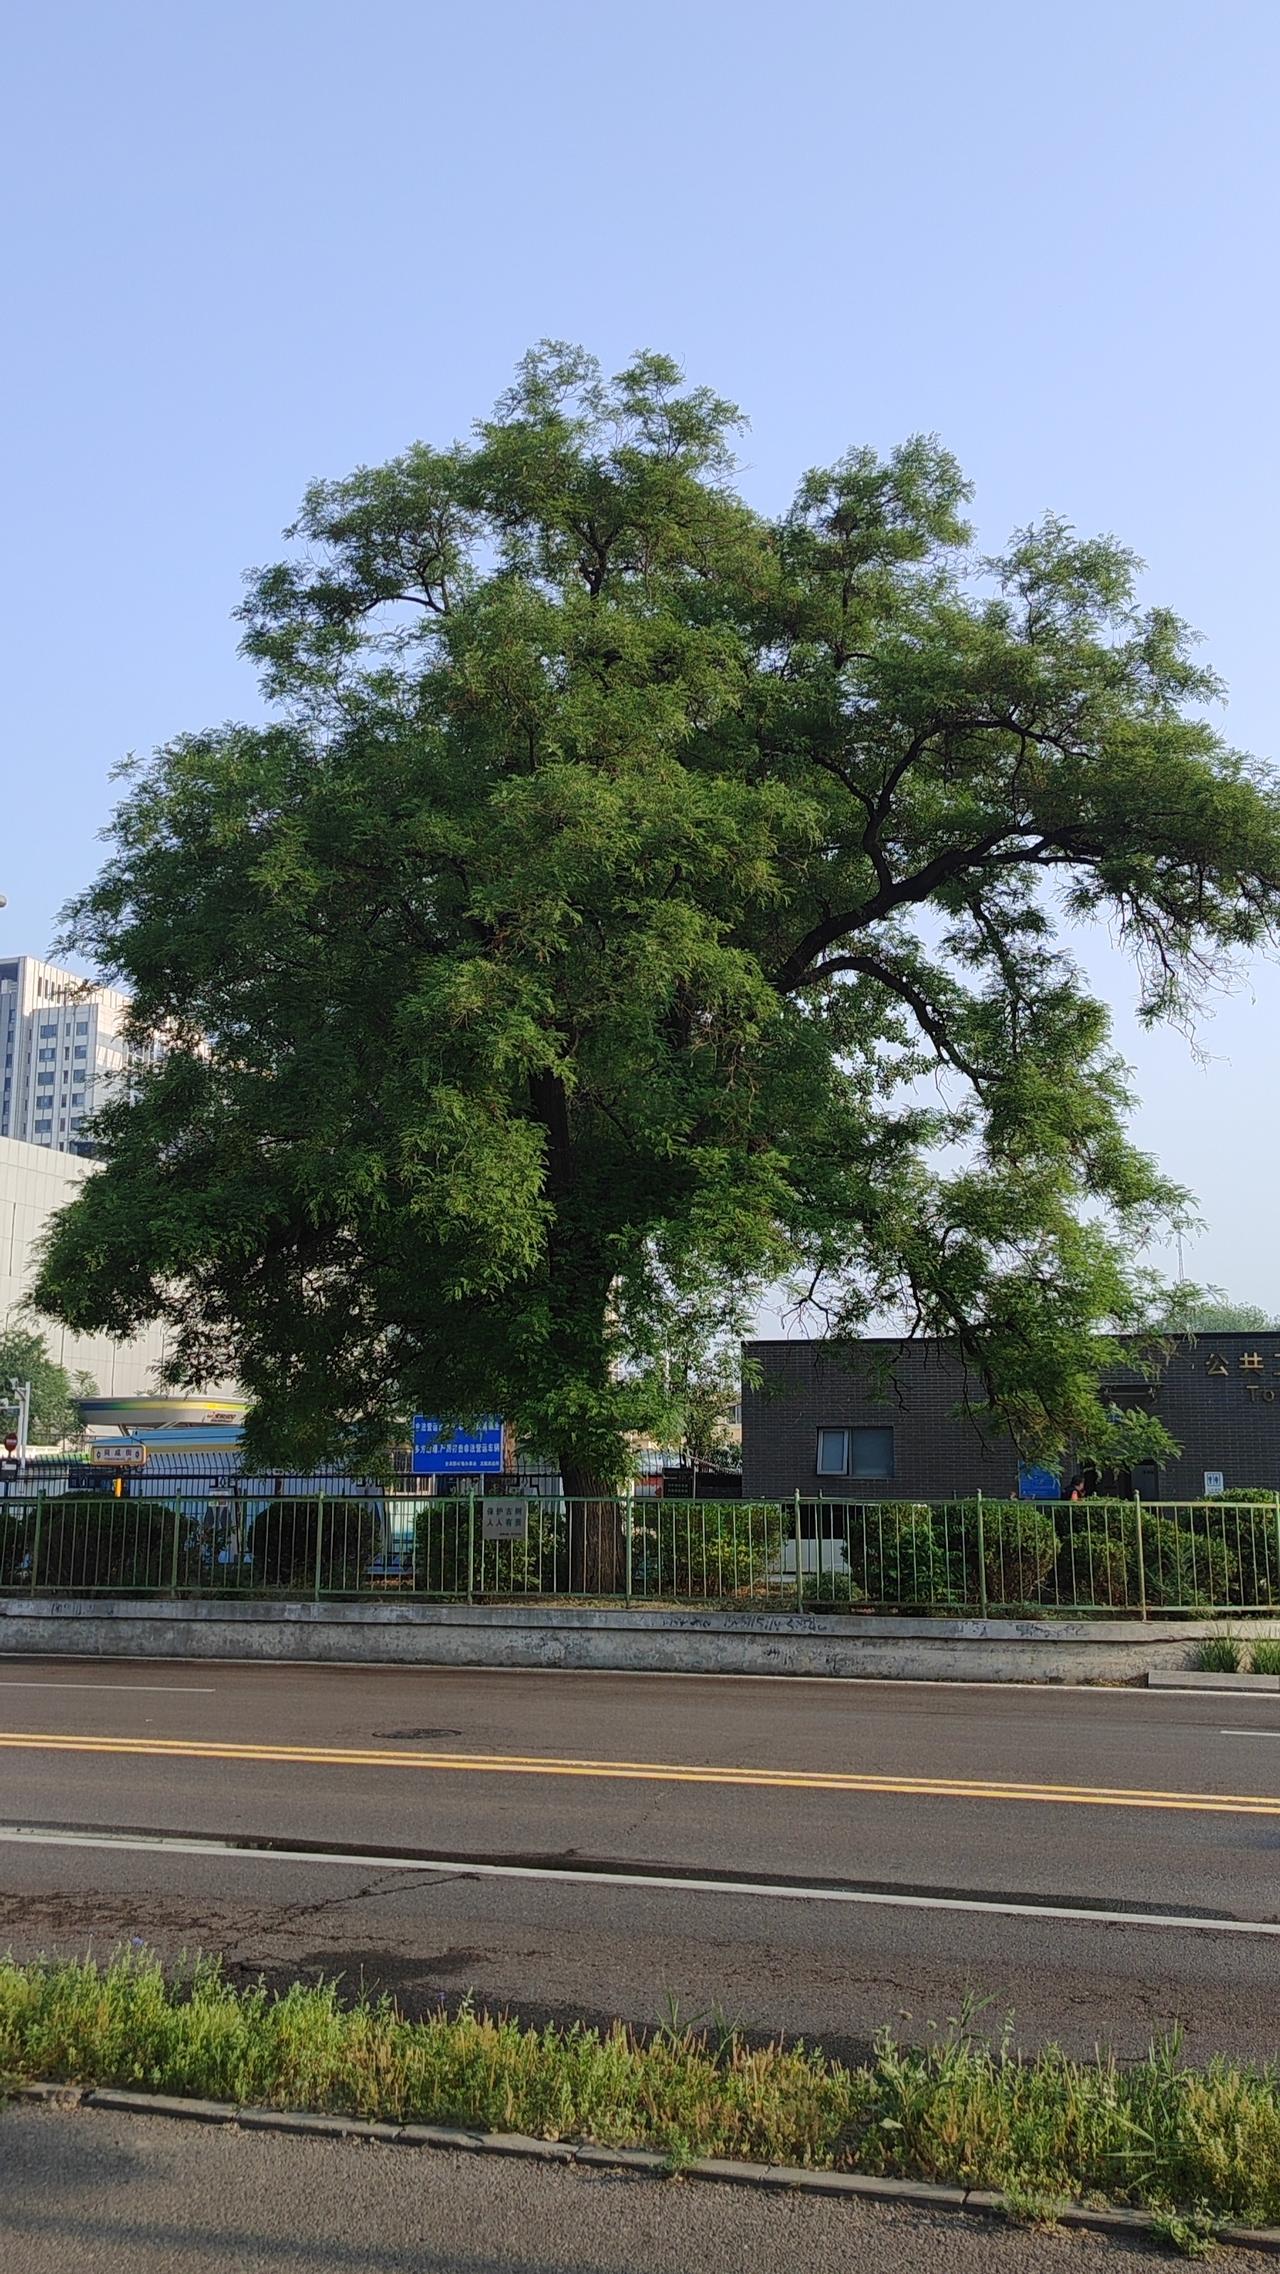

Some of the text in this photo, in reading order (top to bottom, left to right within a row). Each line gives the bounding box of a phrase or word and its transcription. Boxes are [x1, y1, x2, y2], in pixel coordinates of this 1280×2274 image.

[1205, 1352, 1280, 1377] 公共
[486, 1507, 522, 1516] 保护古树
[486, 1518, 522, 1527] 人人有责
